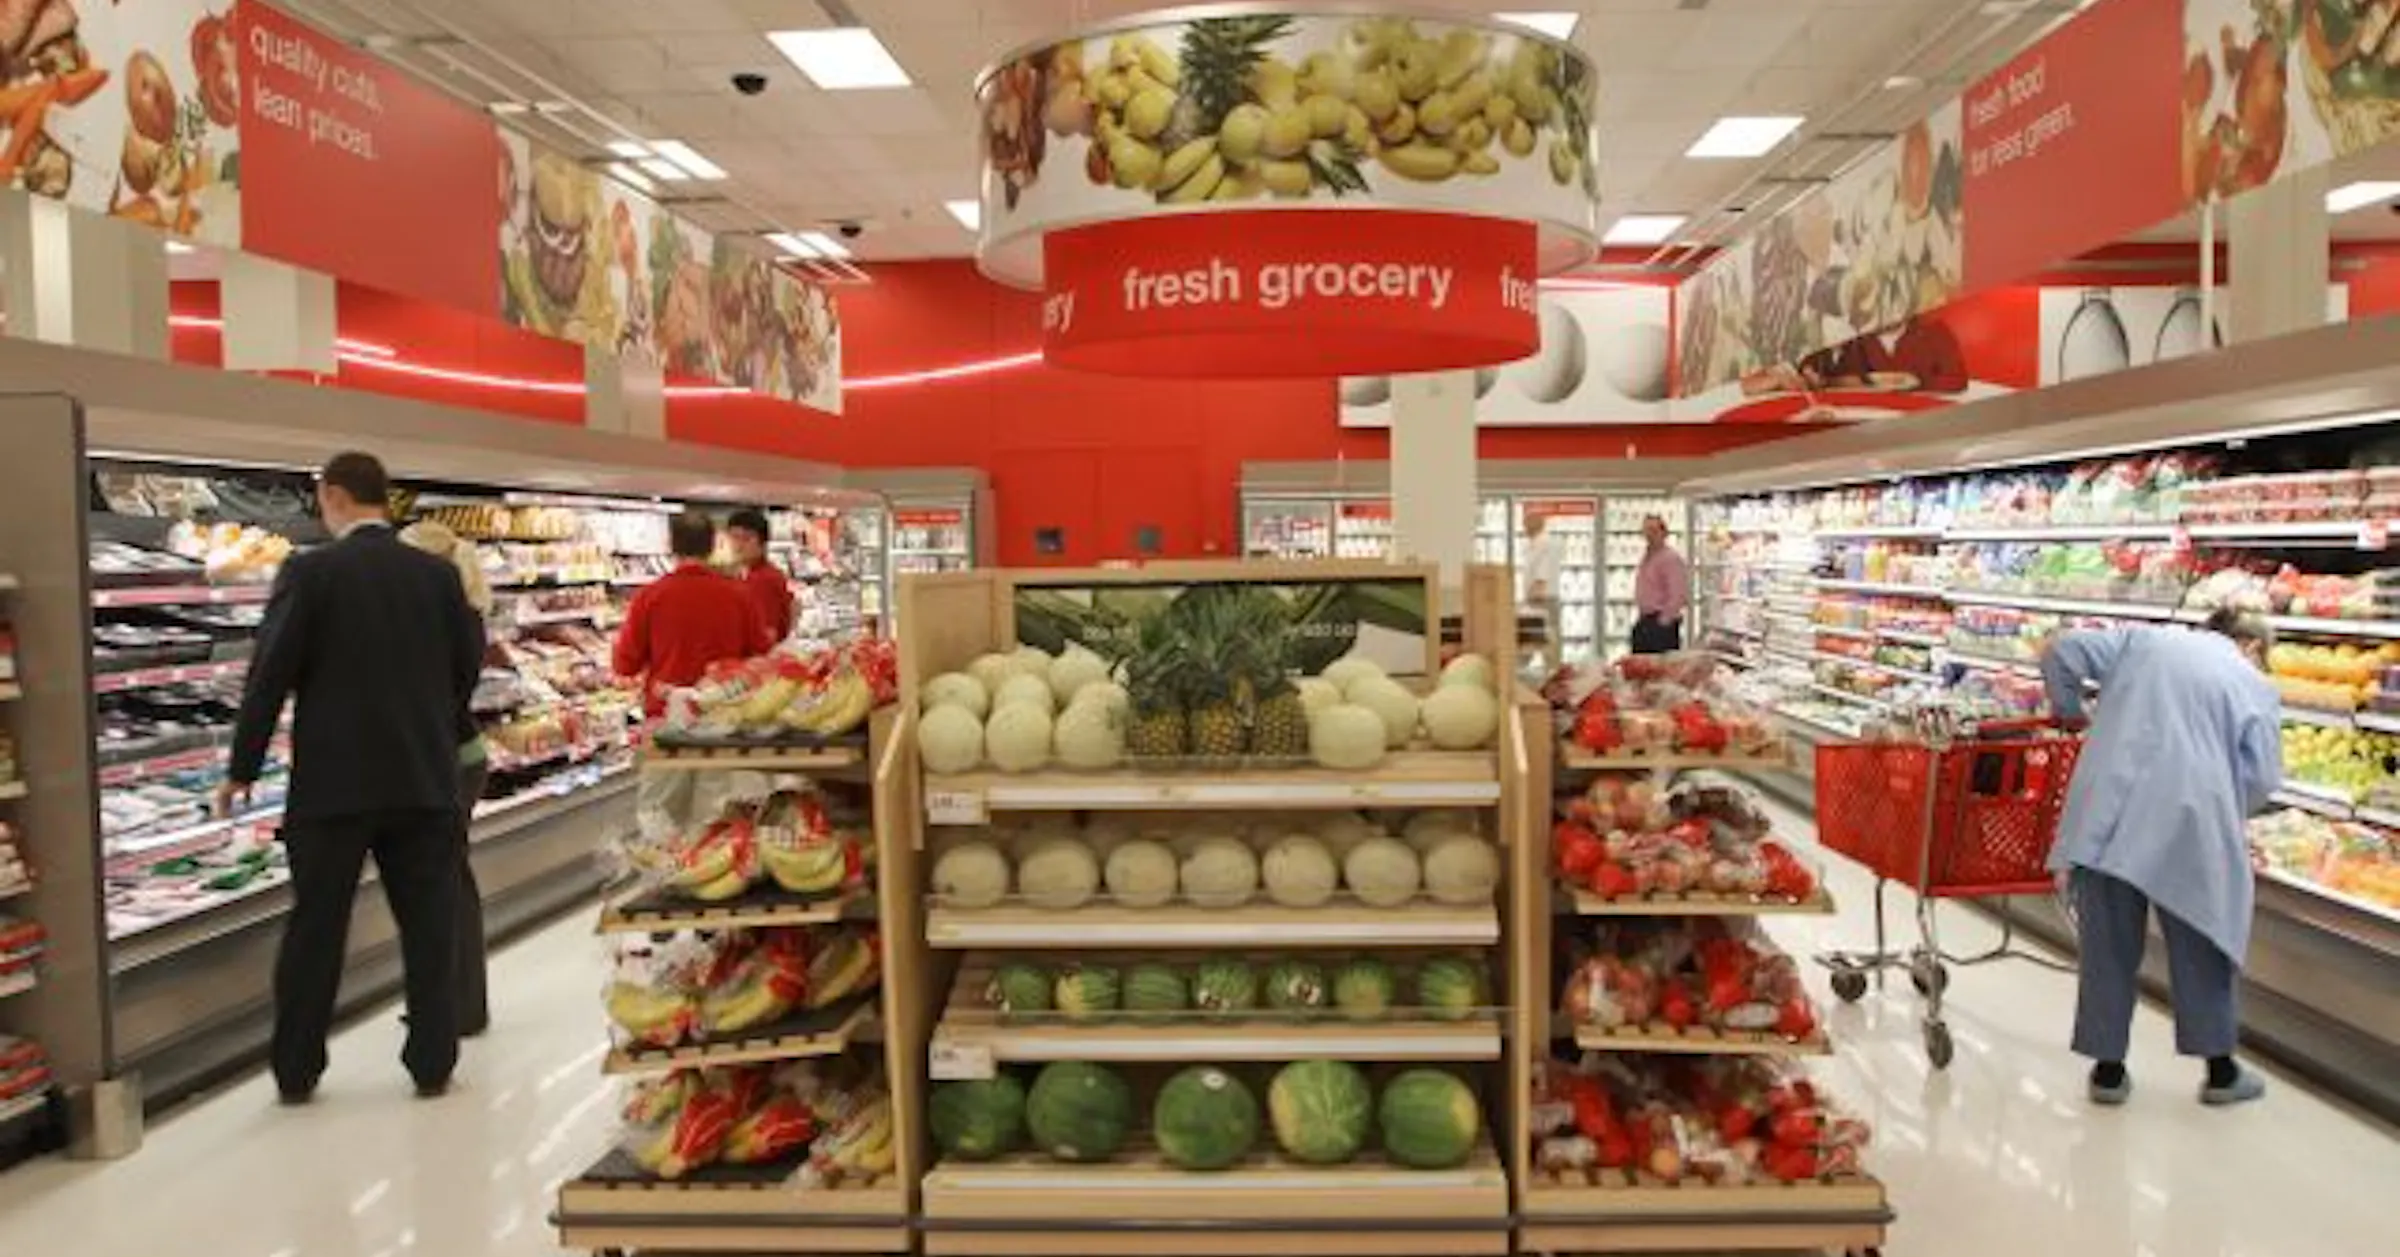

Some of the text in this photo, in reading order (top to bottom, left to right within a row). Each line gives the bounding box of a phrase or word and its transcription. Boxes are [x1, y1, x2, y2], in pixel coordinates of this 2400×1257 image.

[250, 25, 327, 94] quality
[2008, 54, 2046, 108] food
[253, 74, 302, 129] lean
[1123, 257, 1453, 312] fresh grocery
